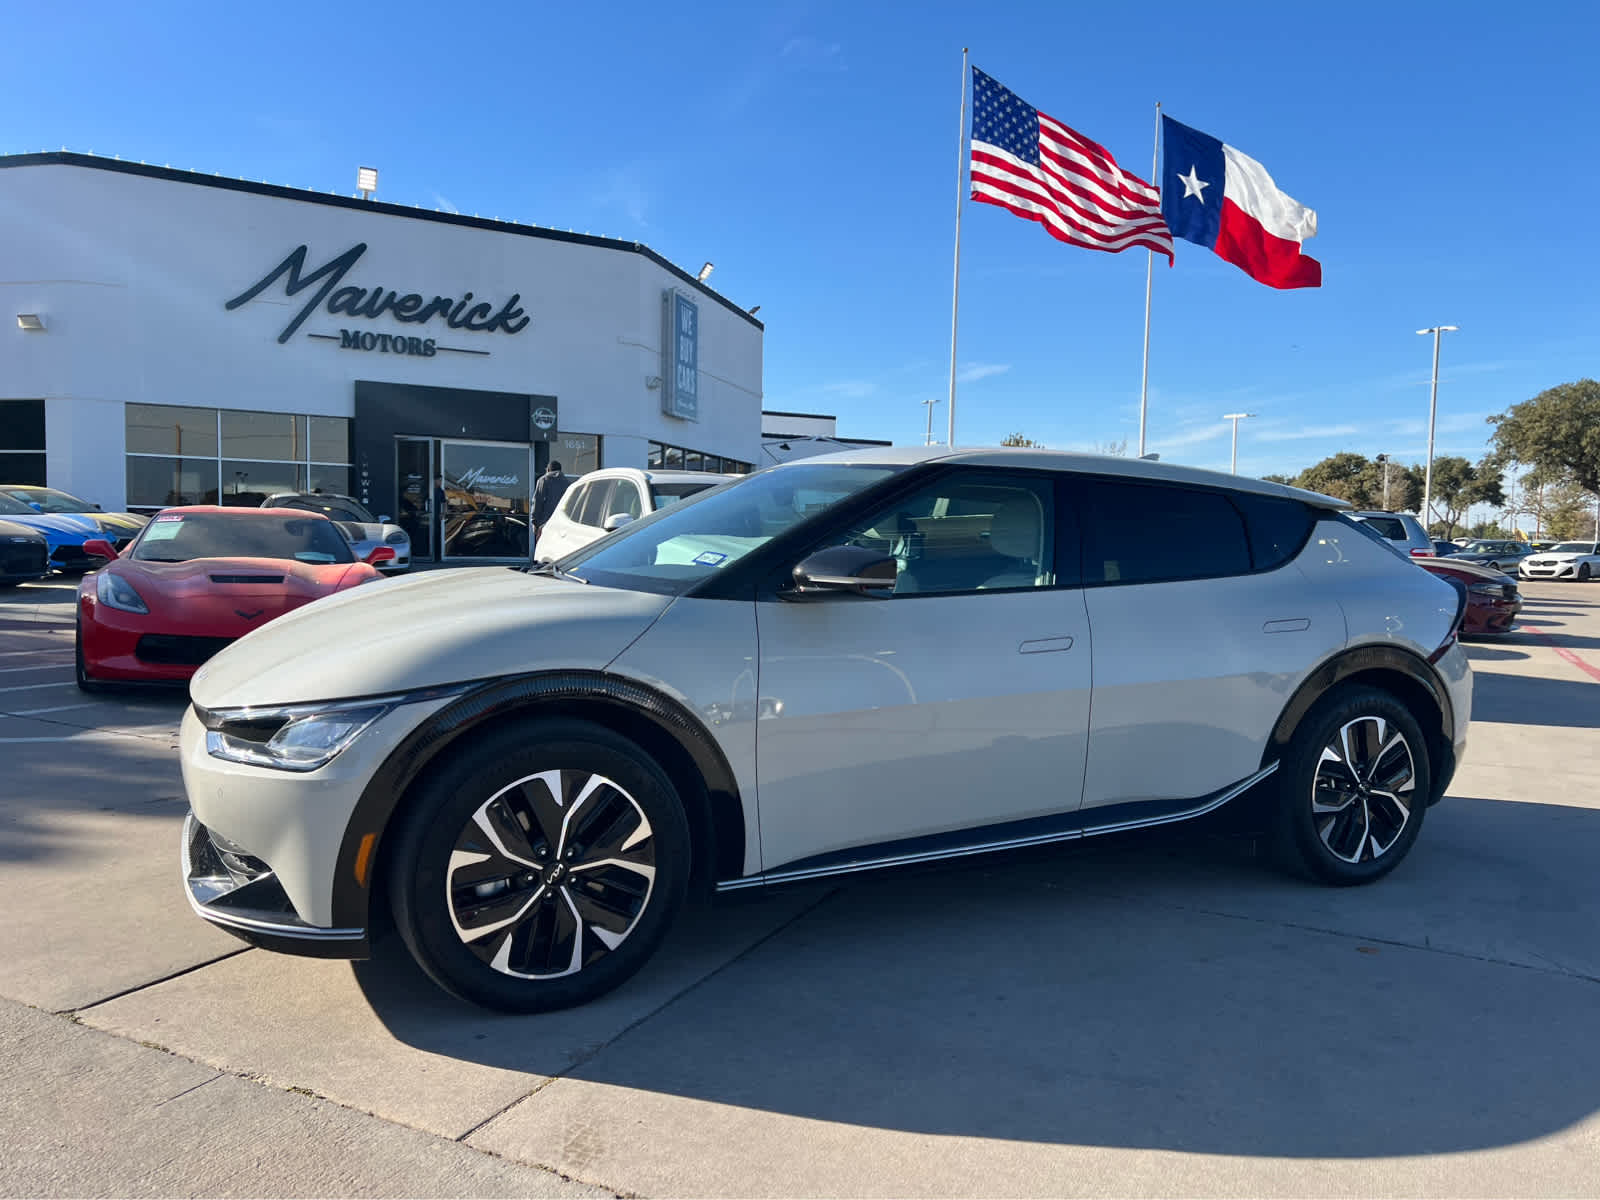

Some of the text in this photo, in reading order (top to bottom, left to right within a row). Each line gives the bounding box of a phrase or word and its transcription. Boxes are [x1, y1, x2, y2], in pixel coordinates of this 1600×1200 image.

[225, 242, 531, 344] Maverick
[680, 303, 693, 337] WE
[340, 329, 437, 358] MOTORS
[679, 334, 694, 366] BUY
[677, 363, 697, 396] CARS
[457, 466, 519, 489] Maverick
